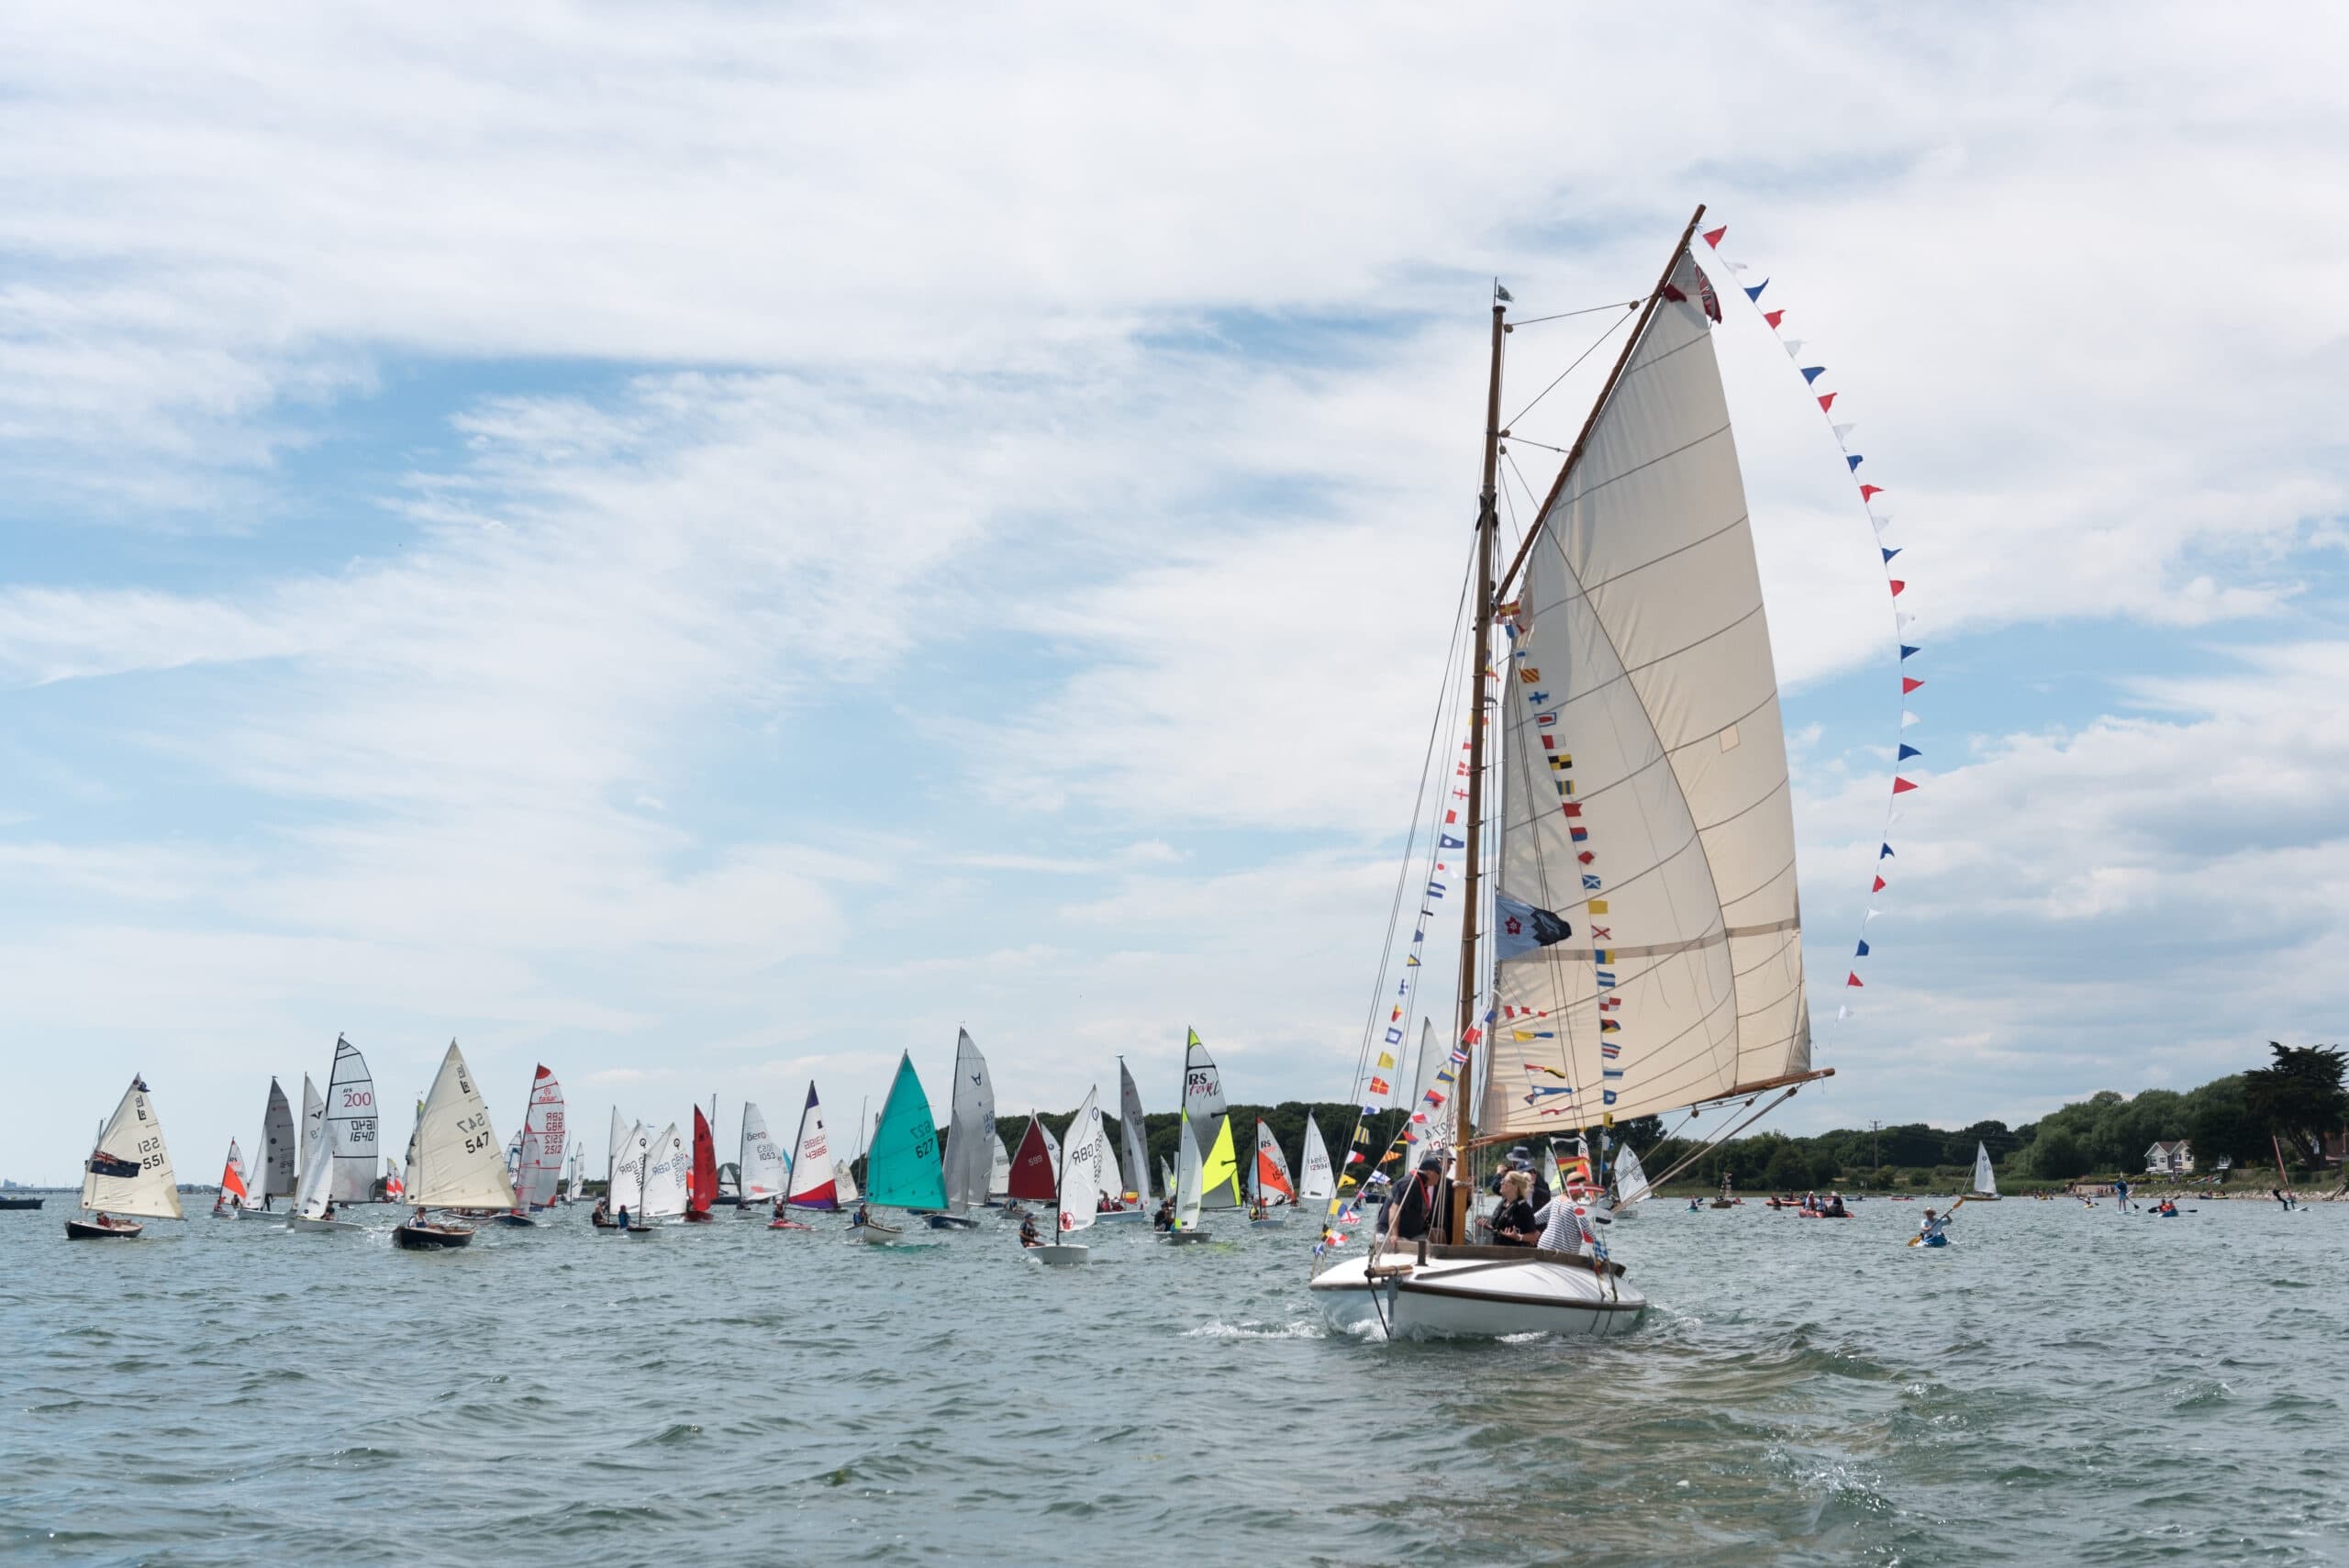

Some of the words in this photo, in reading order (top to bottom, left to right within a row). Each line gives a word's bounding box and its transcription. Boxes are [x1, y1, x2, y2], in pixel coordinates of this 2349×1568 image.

[1189, 1073, 1207, 1084] RS
[343, 1093, 372, 1107] 200
[546, 1122, 562, 1131] GBR
[350, 1131, 375, 1142] 1640
[465, 1131, 489, 1153] 547
[544, 1145, 562, 1154] 2512
[916, 1138, 933, 1159] 627
[142, 1153, 164, 1170] 551
